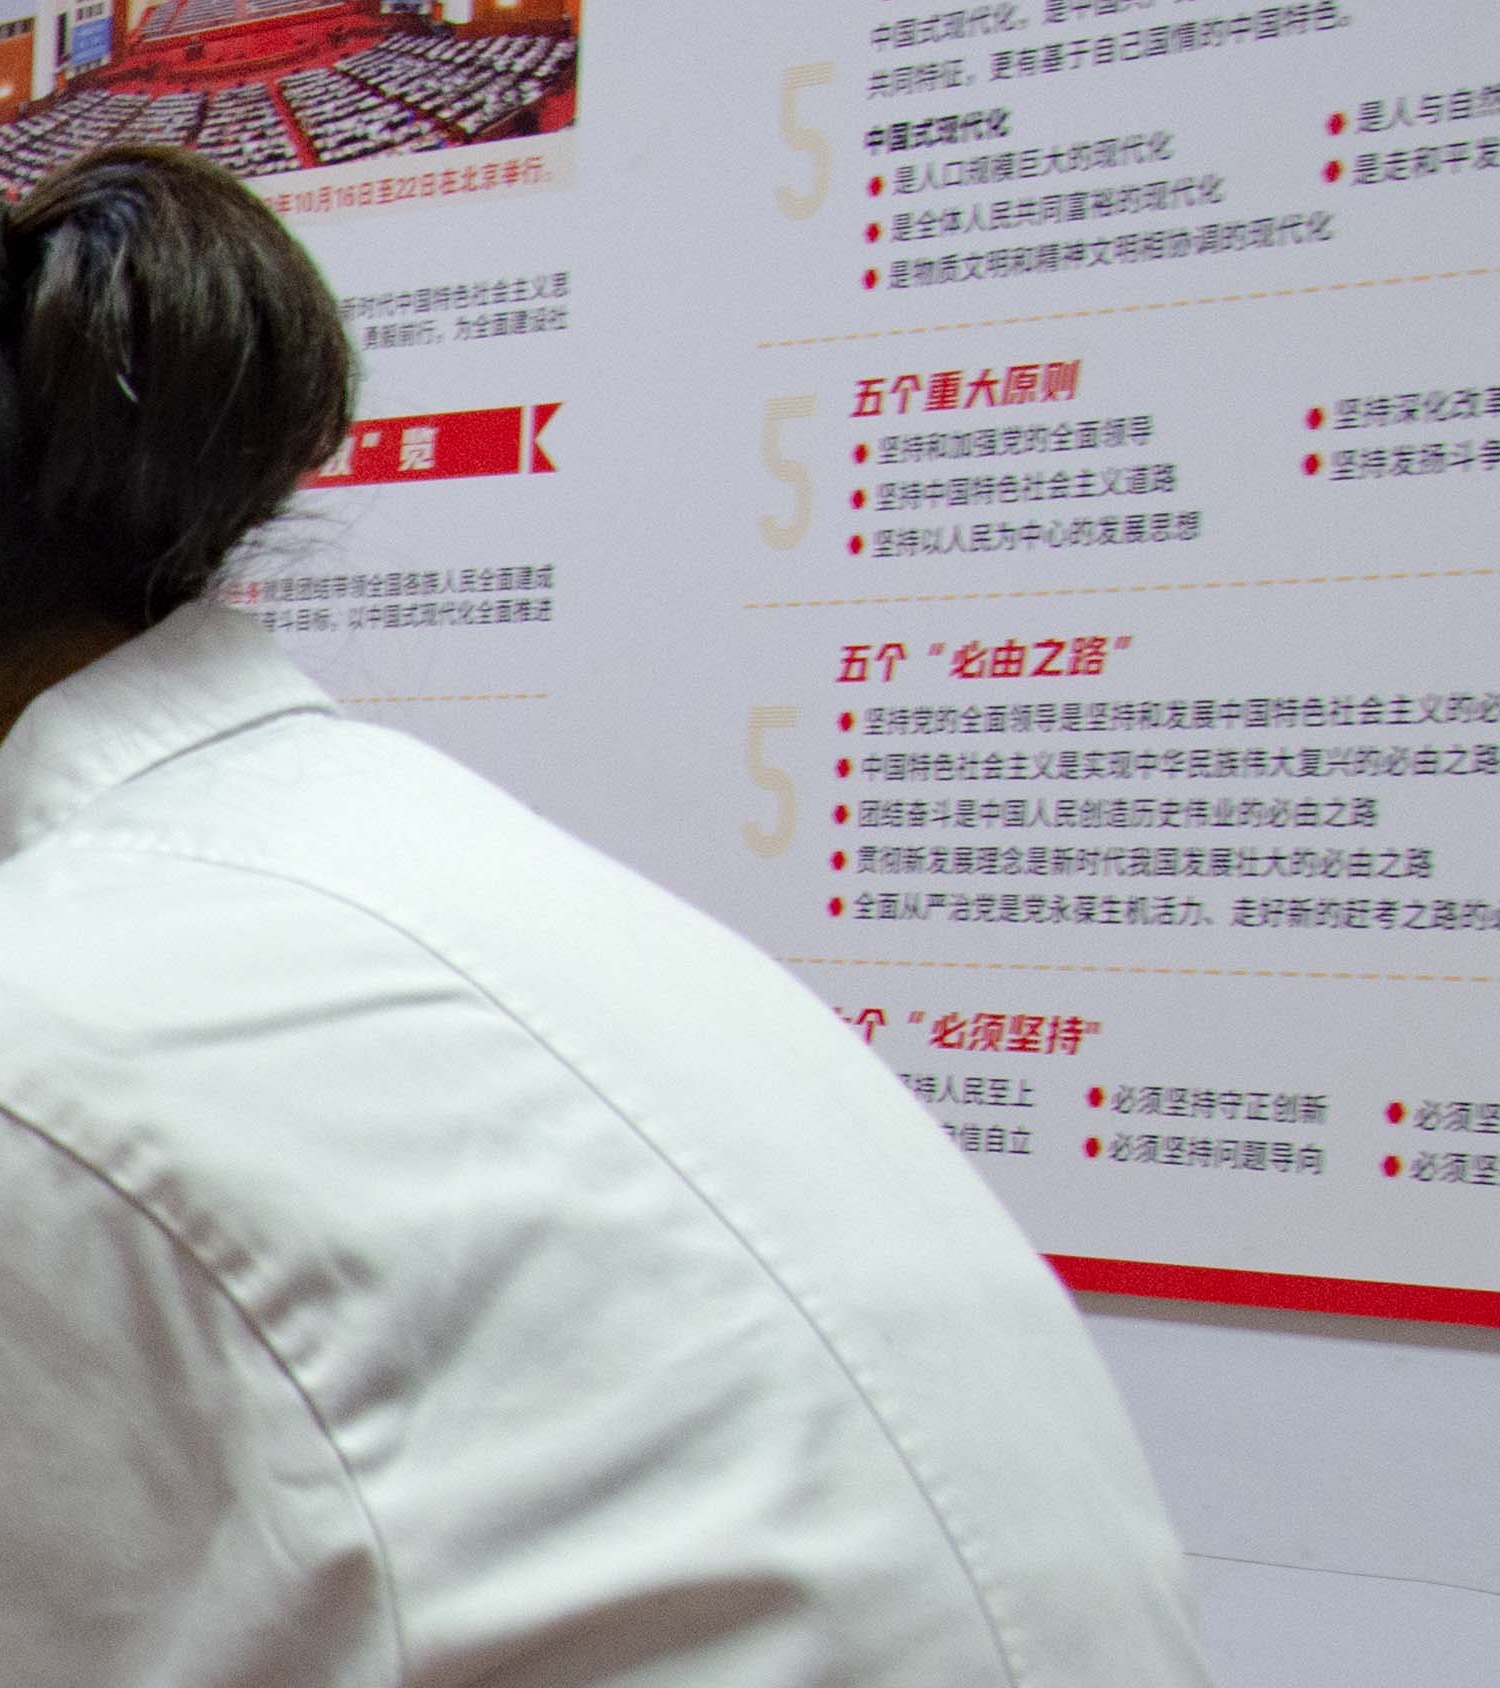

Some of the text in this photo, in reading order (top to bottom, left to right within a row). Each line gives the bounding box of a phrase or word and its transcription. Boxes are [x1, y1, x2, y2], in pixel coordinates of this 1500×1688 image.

[864, 107, 1011, 156] 中国式现代化
[850, 360, 1082, 418] 五个重大原则
[836, 635, 1134, 684] 五个“必由之路”
[832, 1006, 1102, 1056] 个“必须坚持”
